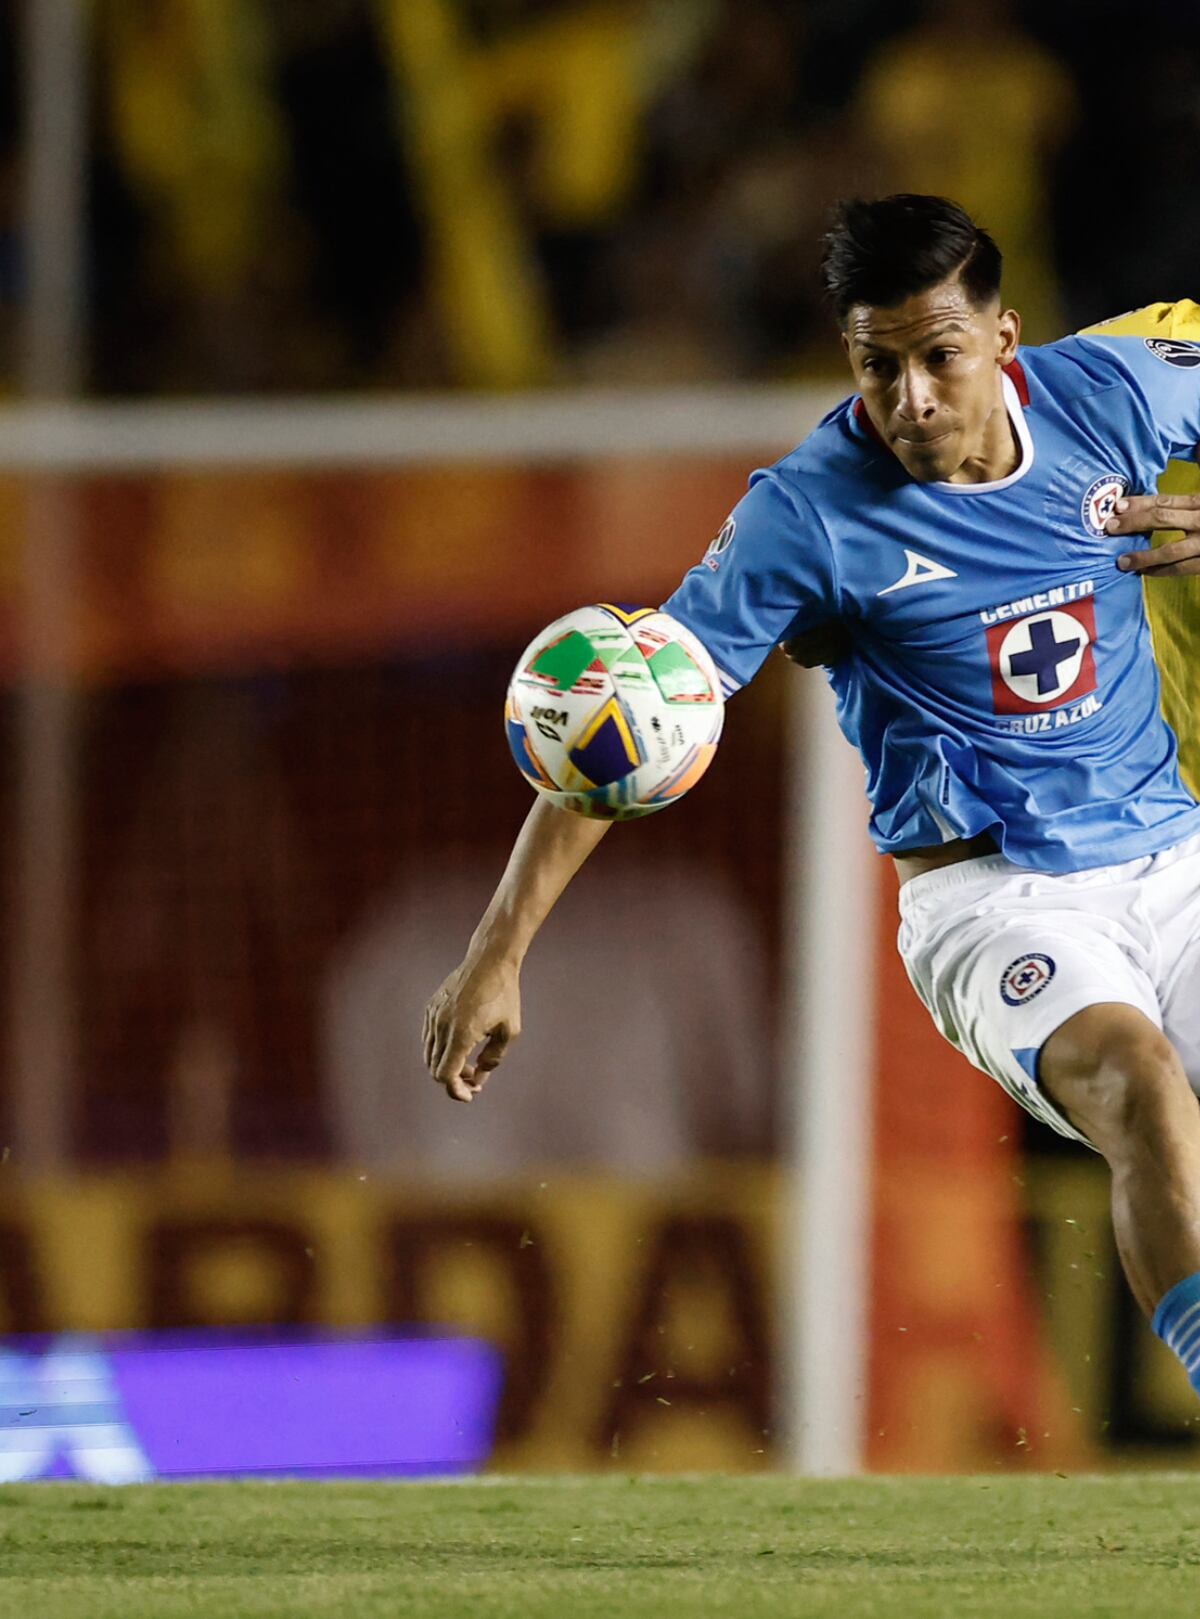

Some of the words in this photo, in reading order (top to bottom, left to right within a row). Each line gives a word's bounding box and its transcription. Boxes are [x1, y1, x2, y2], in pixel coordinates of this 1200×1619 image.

[980, 580, 1094, 624] CEMENTO
[995, 713, 1052, 734] CRUZ
[1055, 695, 1103, 729] AZUL
